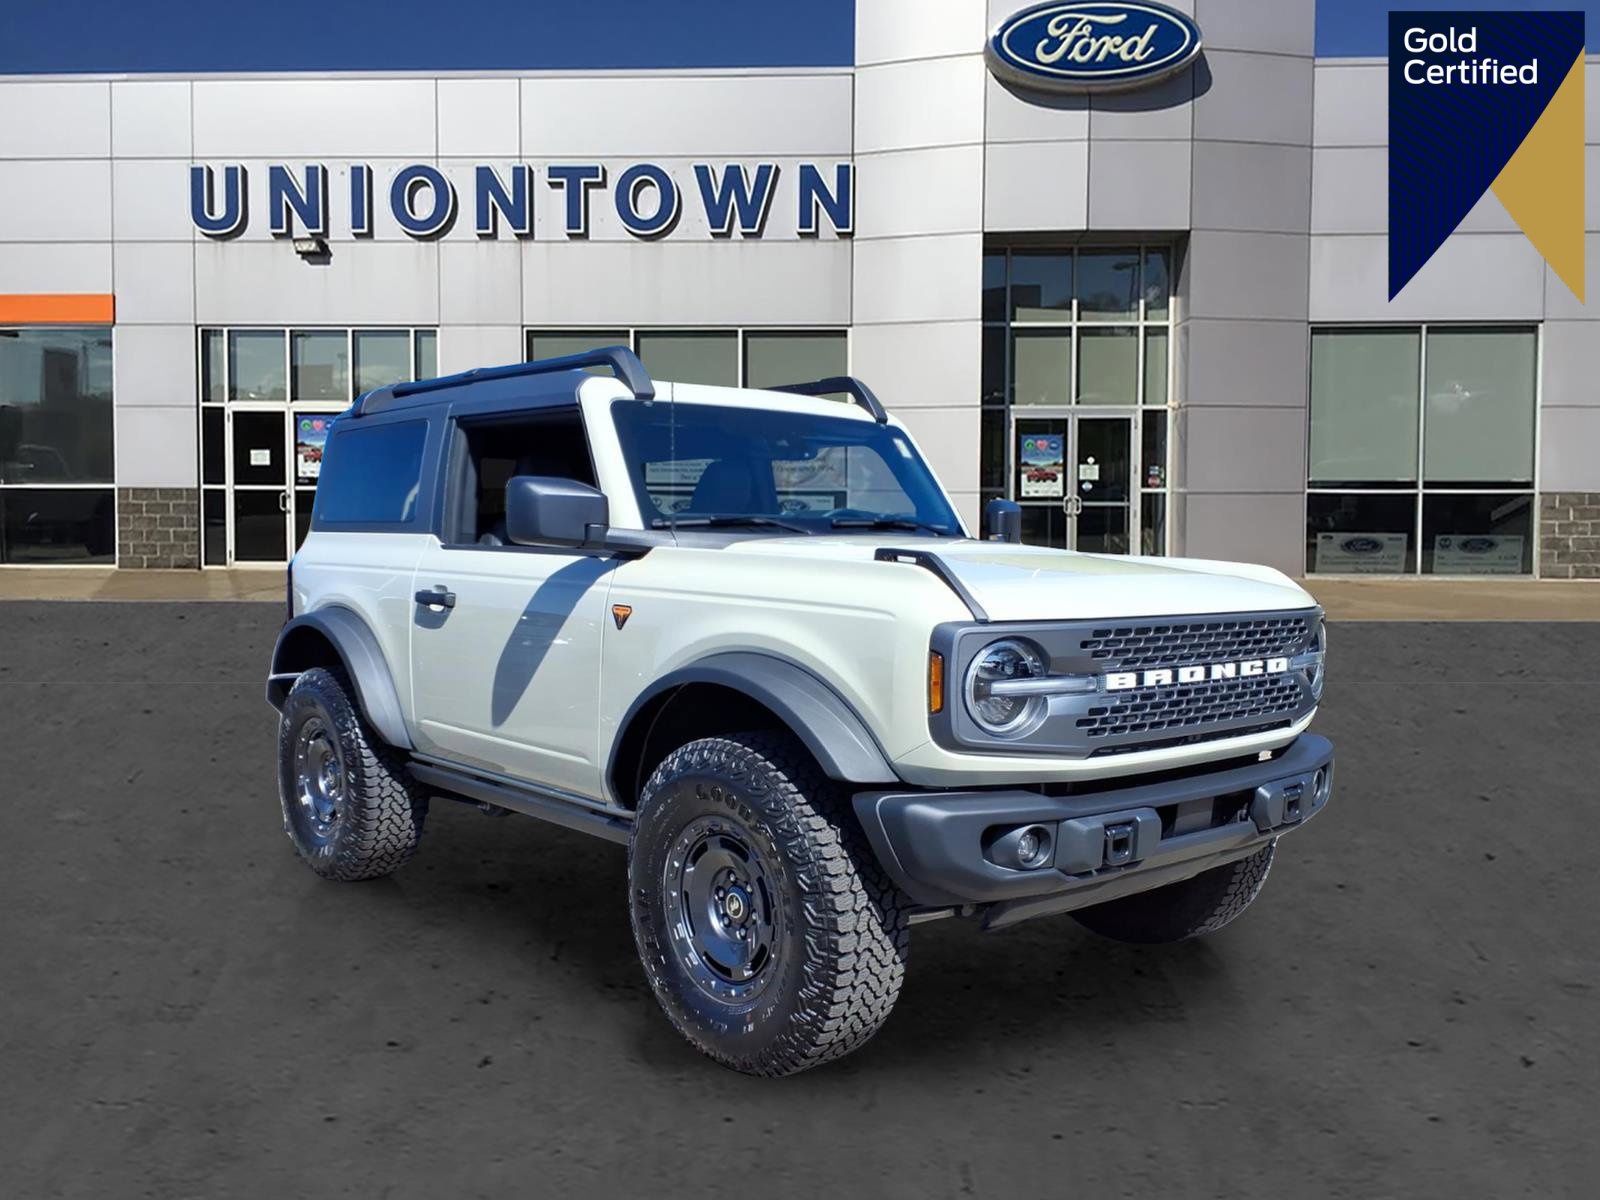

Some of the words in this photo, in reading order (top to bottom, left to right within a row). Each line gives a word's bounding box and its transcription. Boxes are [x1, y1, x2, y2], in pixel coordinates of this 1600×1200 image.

[1035, 12, 1159, 64] Ford
[190, 161, 855, 238] UNIONTOWN
[1105, 656, 1288, 690] BRONCO
